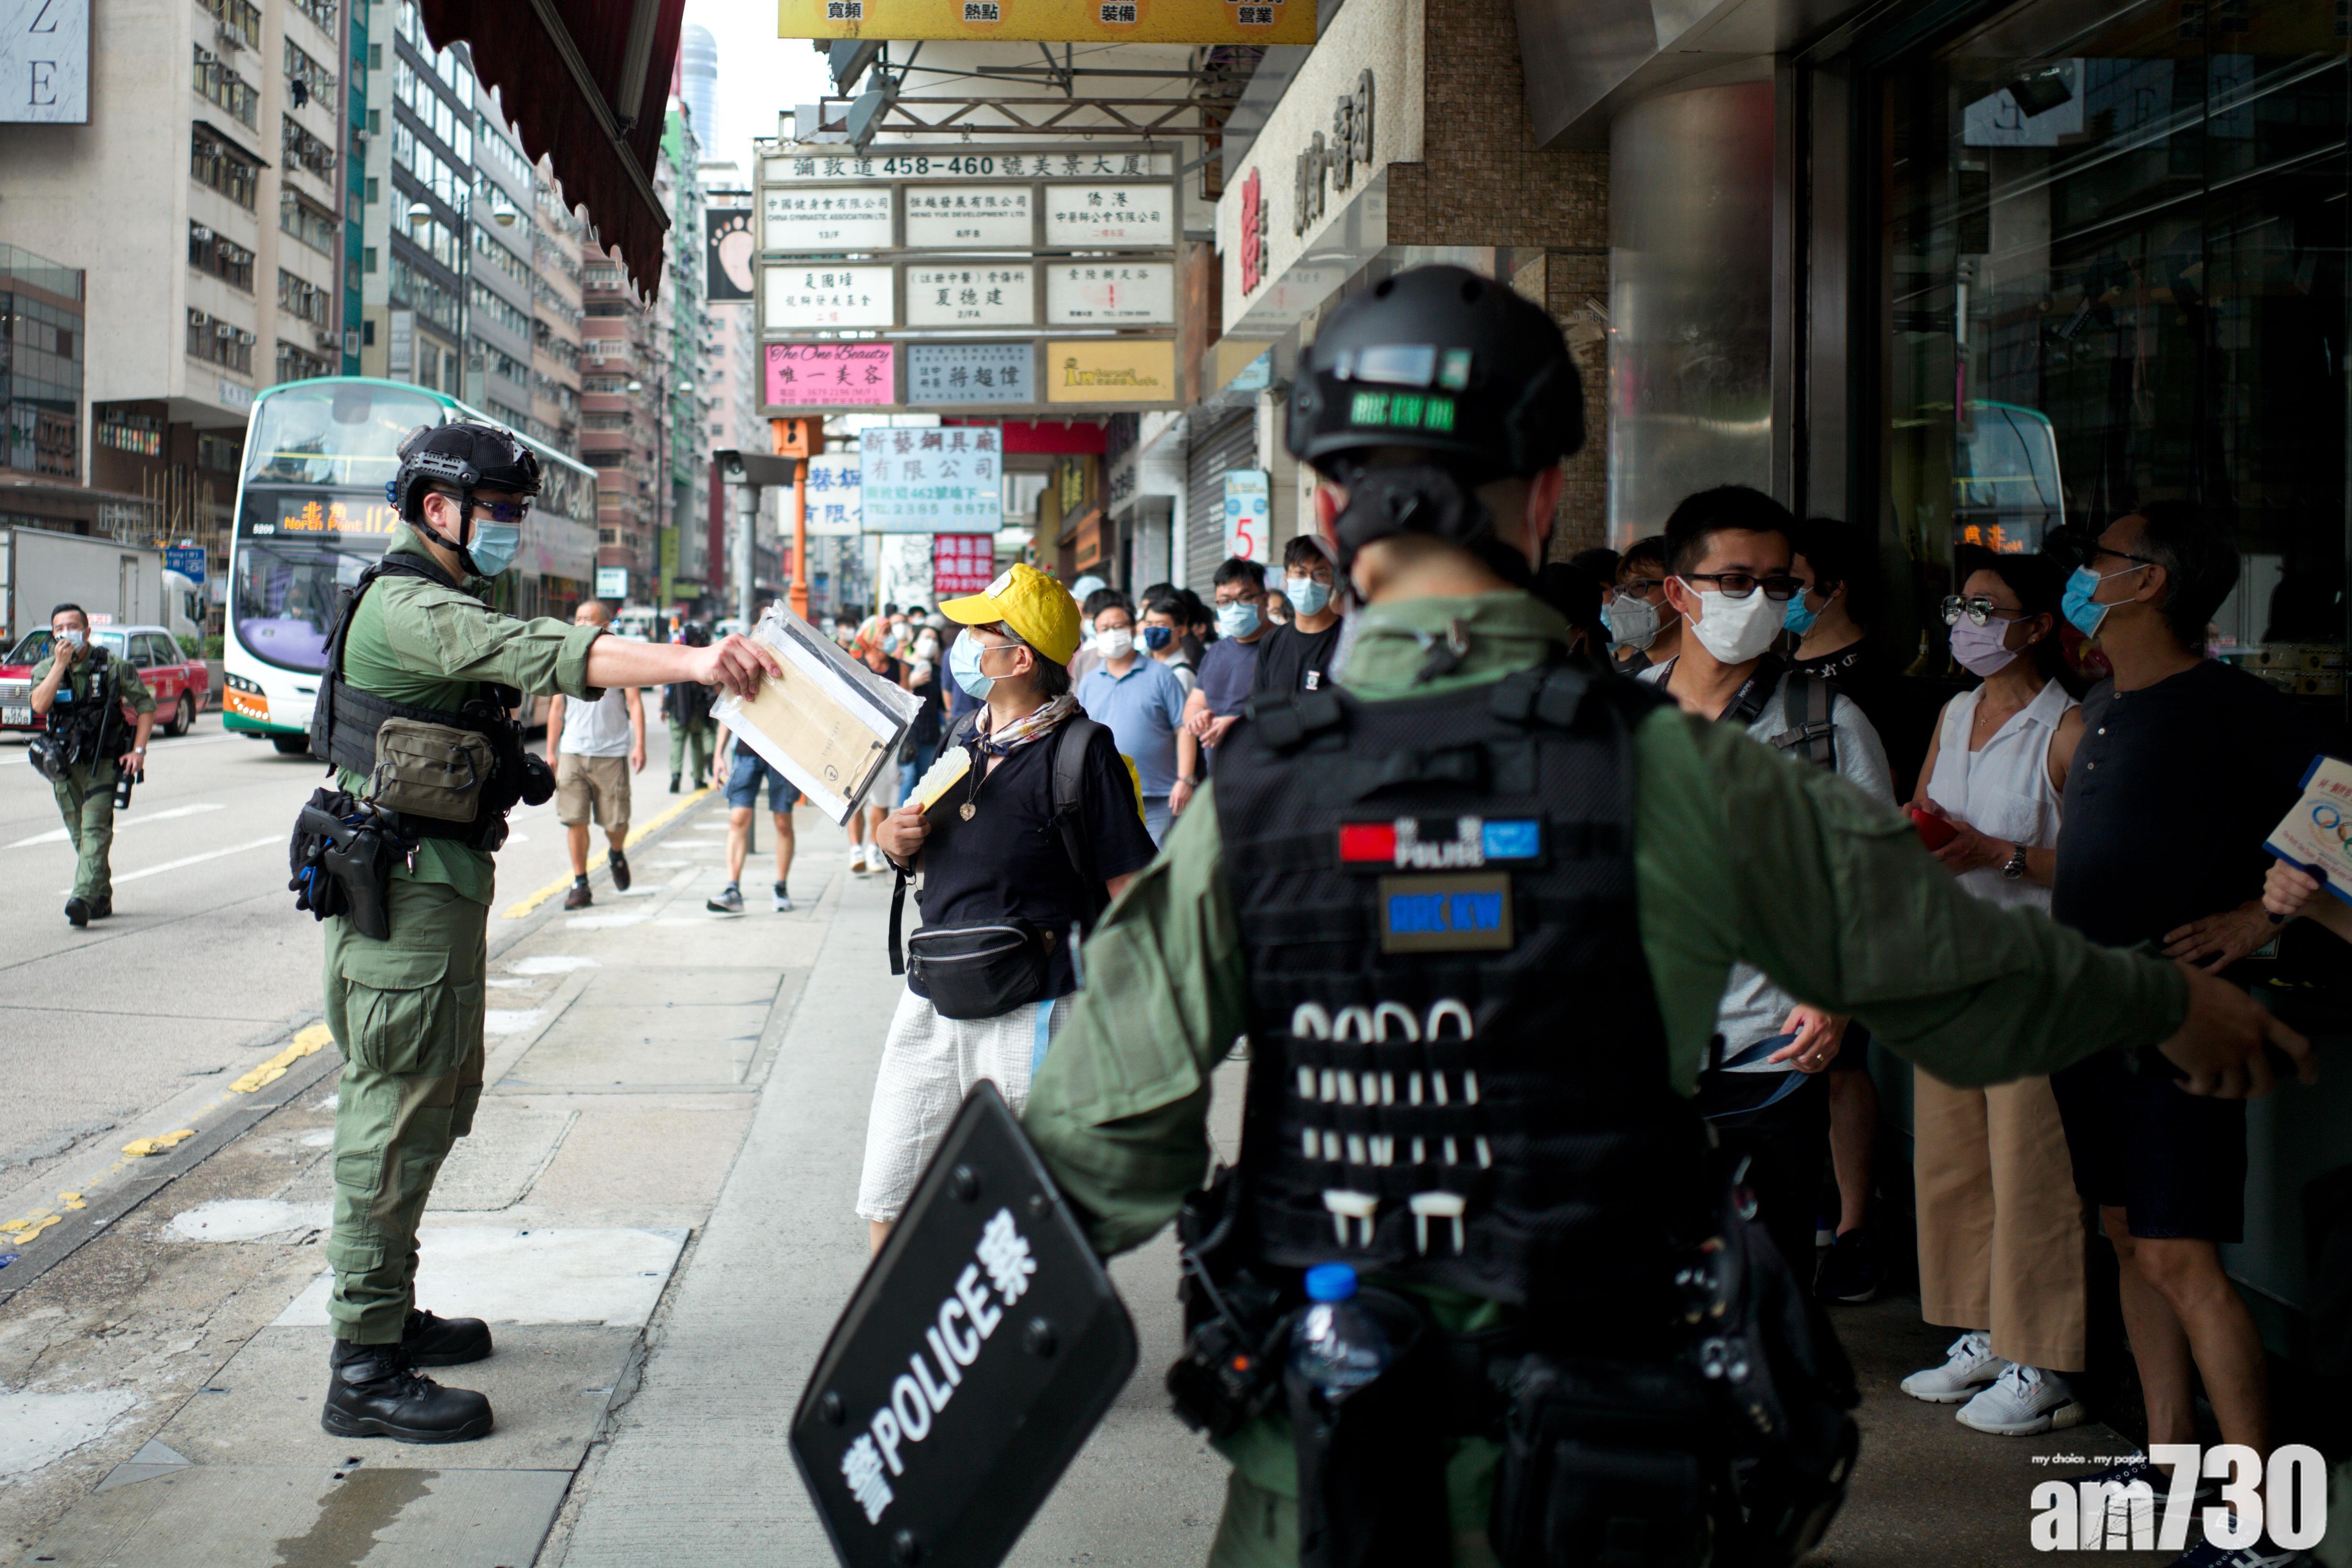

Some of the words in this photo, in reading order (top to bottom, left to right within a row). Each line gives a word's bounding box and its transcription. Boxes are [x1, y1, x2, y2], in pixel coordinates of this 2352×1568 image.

[828, 3, 861, 19] 寬頻
[965, 4, 998, 20] 熱點
[1102, 5, 1135, 21] 裝備
[1239, 7, 1272, 24] 營業
[768, 198, 887, 210] 中國健身會有限公司
[1088, 192, 1127, 207] 僑港
[1056, 212, 1160, 223] 中醫師公會有限公司
[786, 295, 872, 307] 龍獅發展基金
[935, 288, 1003, 306] 夏德建
[769, 344, 798, 362] The
[801, 344, 832, 361] One
[834, 344, 890, 363] Beauty
[778, 365, 883, 386] 唯一美容
[864, 430, 998, 454] 新藝鋼具廠
[872, 458, 994, 481] 有限公司
[301, 501, 346, 519] 北角
[284, 516, 323, 531] North
[327, 517, 362, 532] Point
[365, 506, 399, 533] 112
[1394, 841, 1485, 869] POLICE
